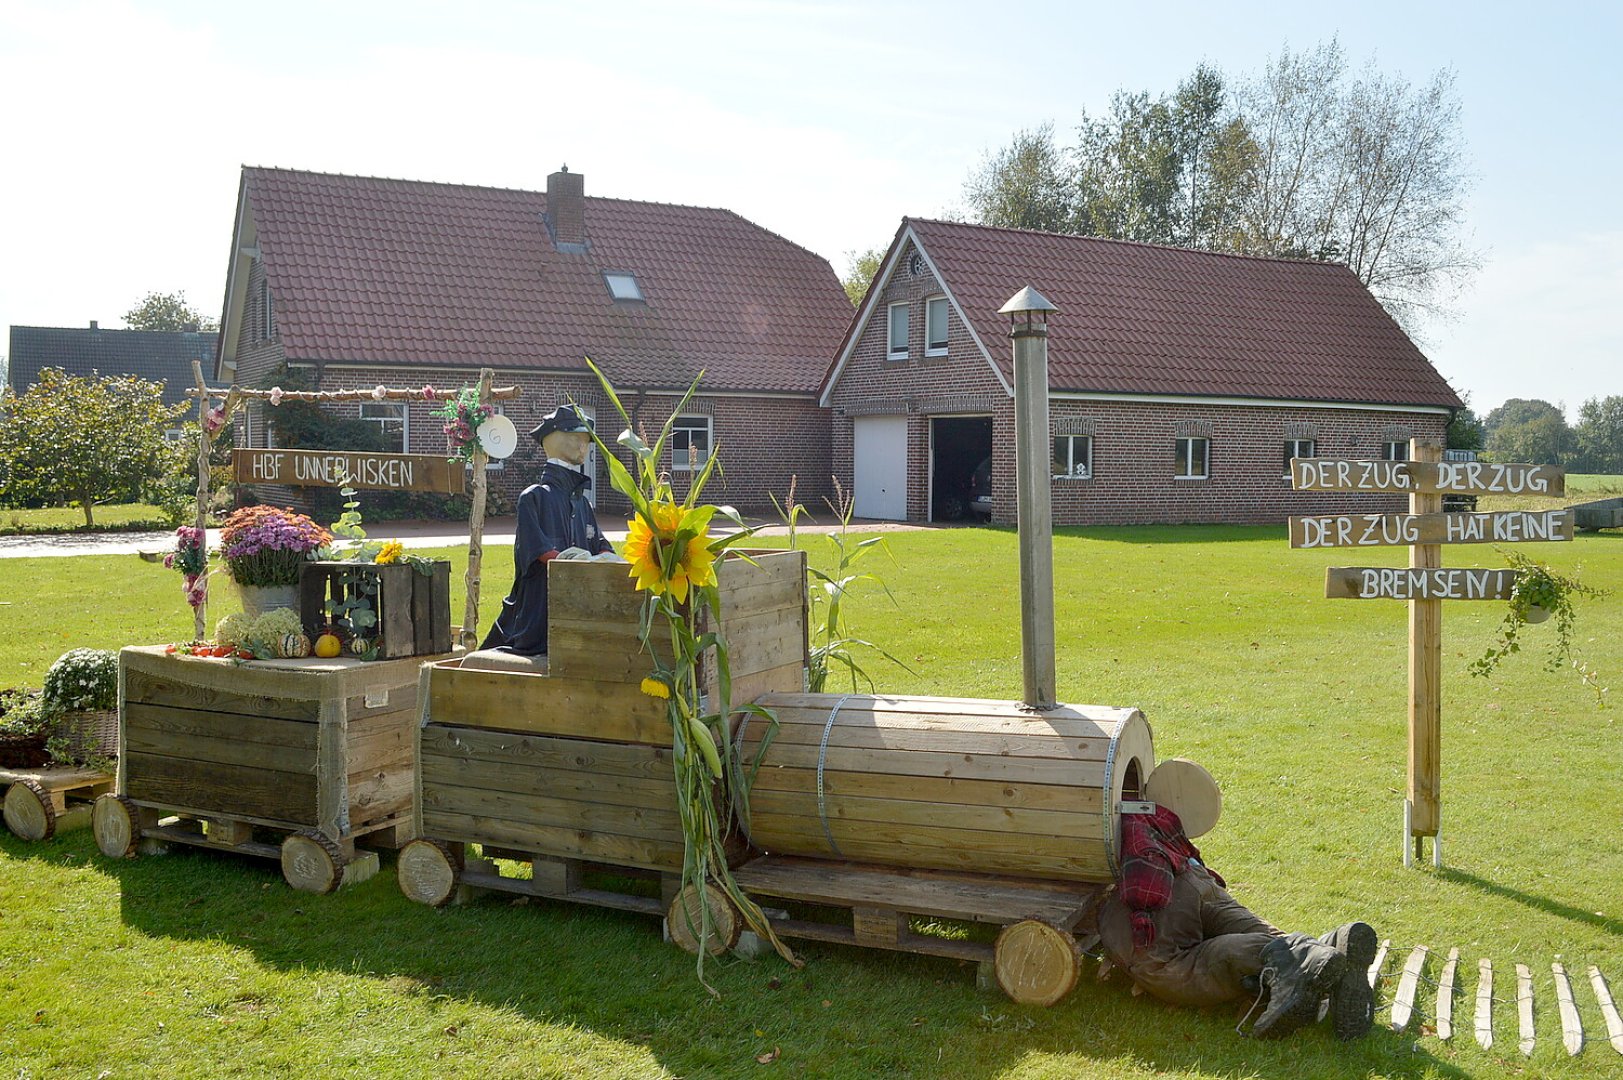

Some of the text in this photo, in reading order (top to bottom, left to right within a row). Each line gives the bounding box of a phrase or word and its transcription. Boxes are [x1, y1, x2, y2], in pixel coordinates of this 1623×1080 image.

[252, 453, 285, 480] HBF
[1299, 461, 1352, 489] DER
[1435, 461, 1486, 490] DER
[1488, 464, 1548, 493] ZUG
[1300, 511, 1567, 549] DER ZUG HAT KEINE
